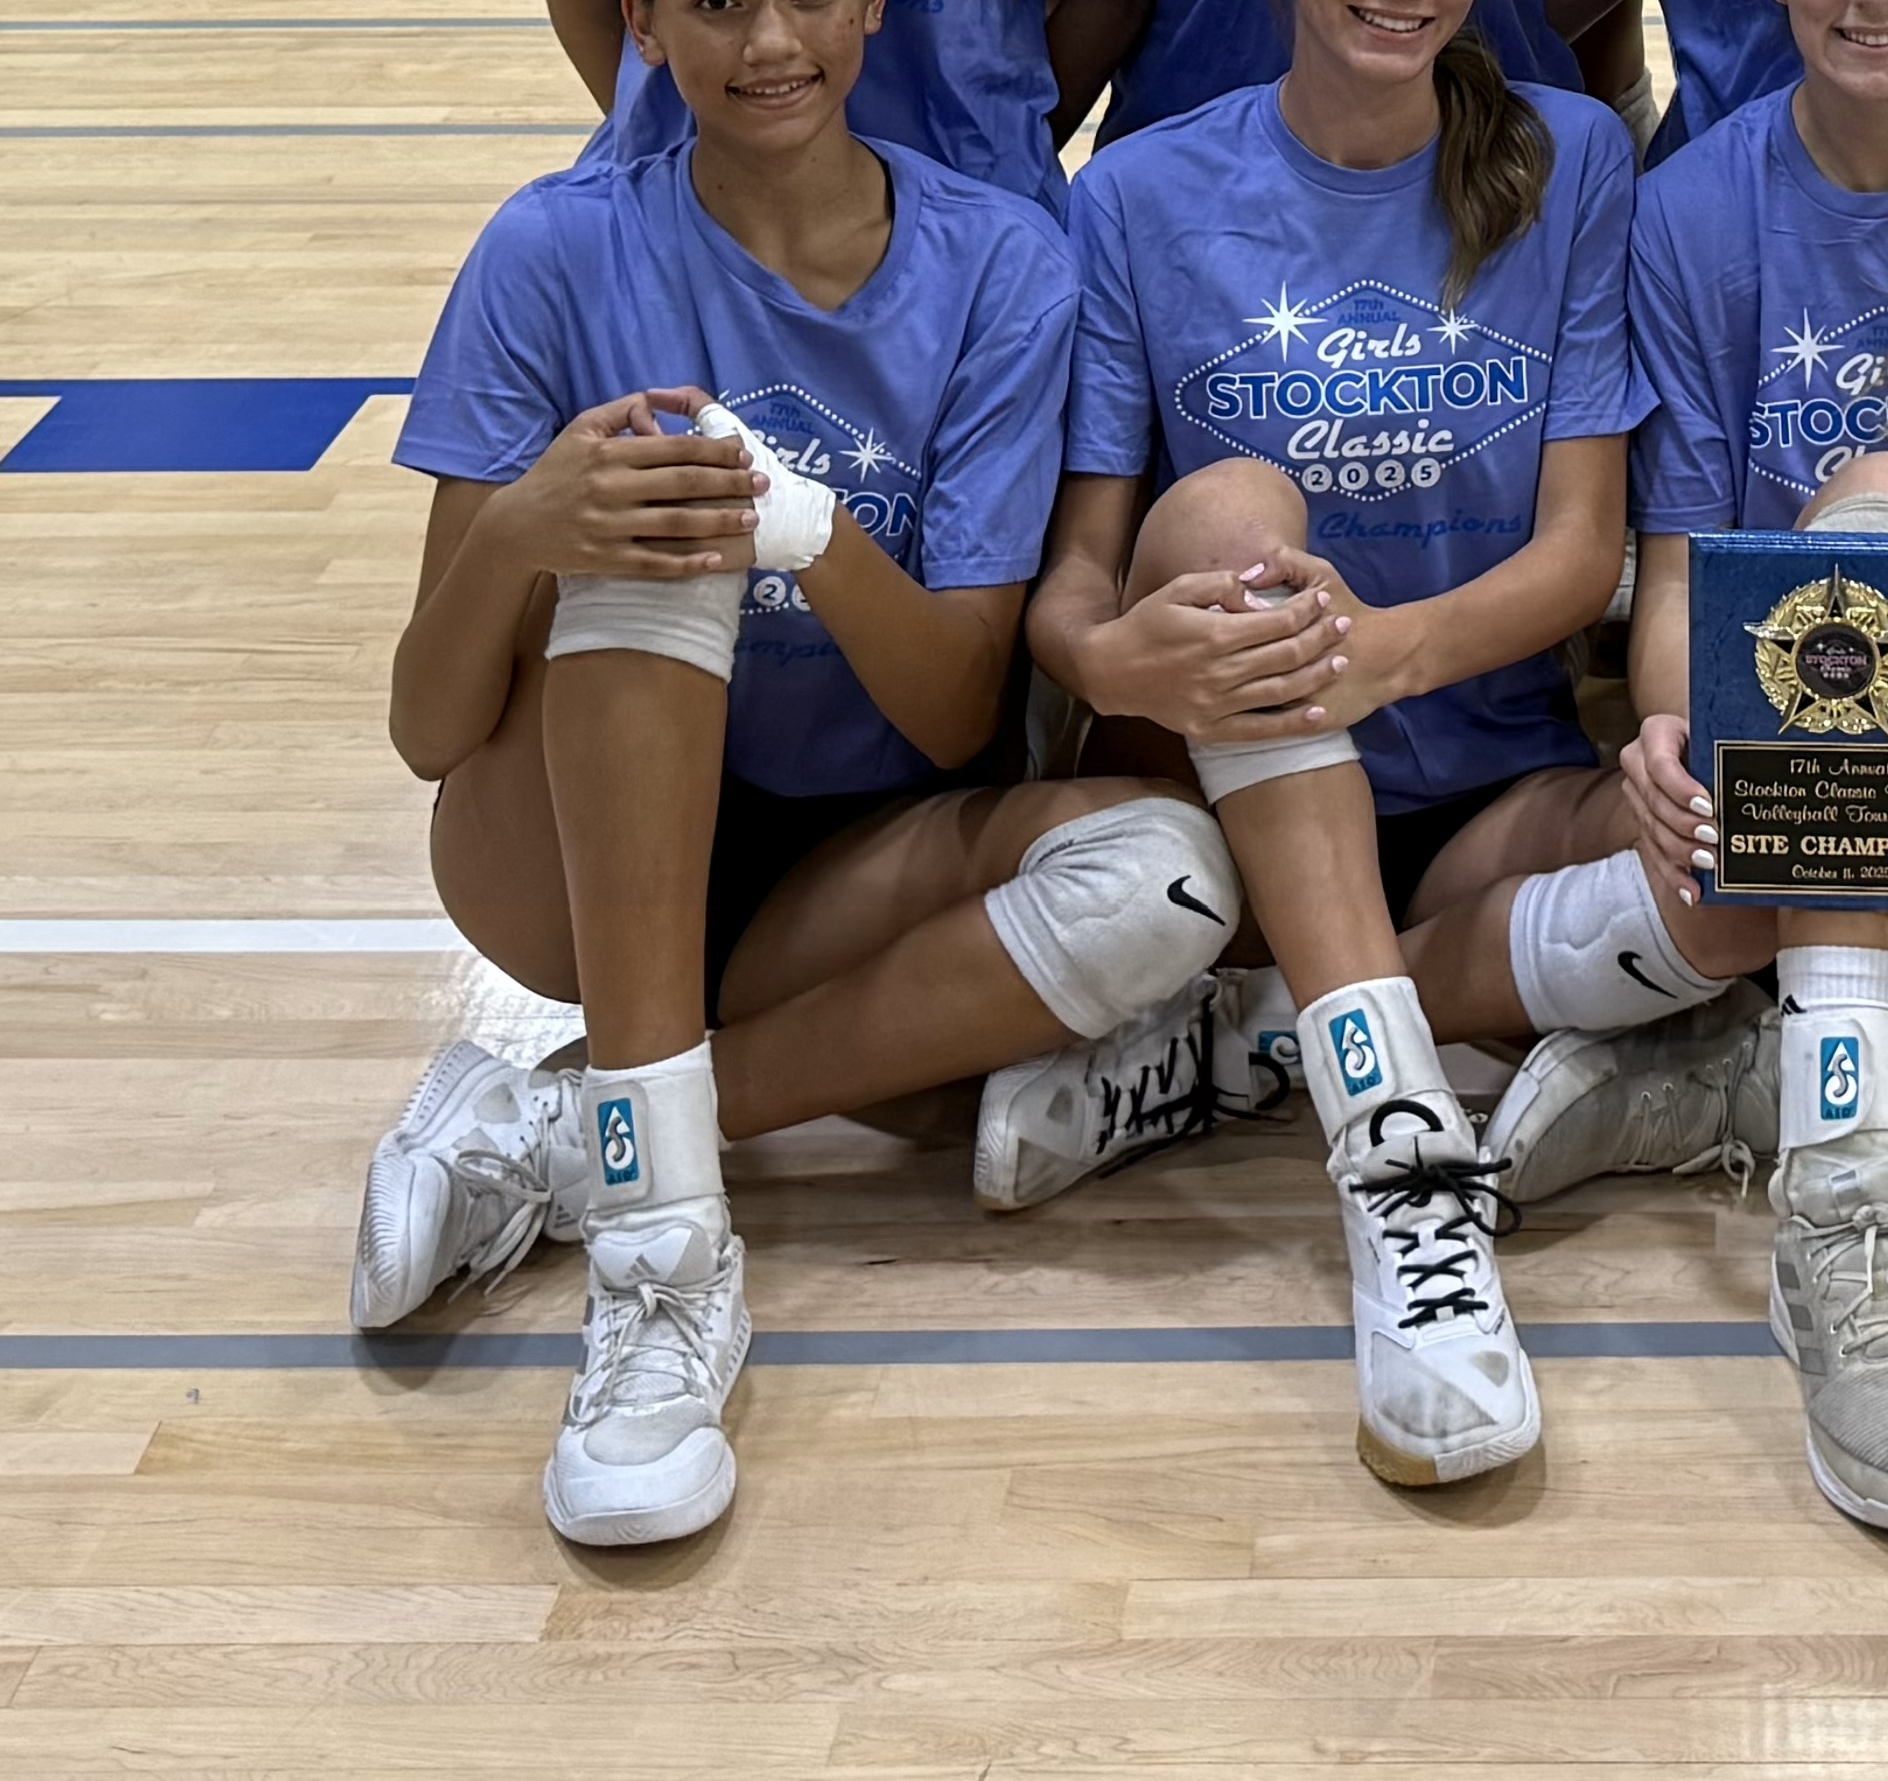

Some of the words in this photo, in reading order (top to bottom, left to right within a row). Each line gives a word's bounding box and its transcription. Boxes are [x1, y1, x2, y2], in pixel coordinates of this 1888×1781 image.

[1316, 323, 1423, 369] Girls
[1205, 356, 1529, 420] STOCKTON
[1287, 418, 1456, 460] Classic
[1316, 509, 1522, 550] Champions
[1790, 758, 1821, 775] 17th
[1734, 779, 1807, 798] Stockton
[1814, 780, 1877, 800] Classic
[1741, 802, 1839, 825] Volleyball
[1730, 834, 1790, 855] SITE
[1791, 864, 1838, 880] October
